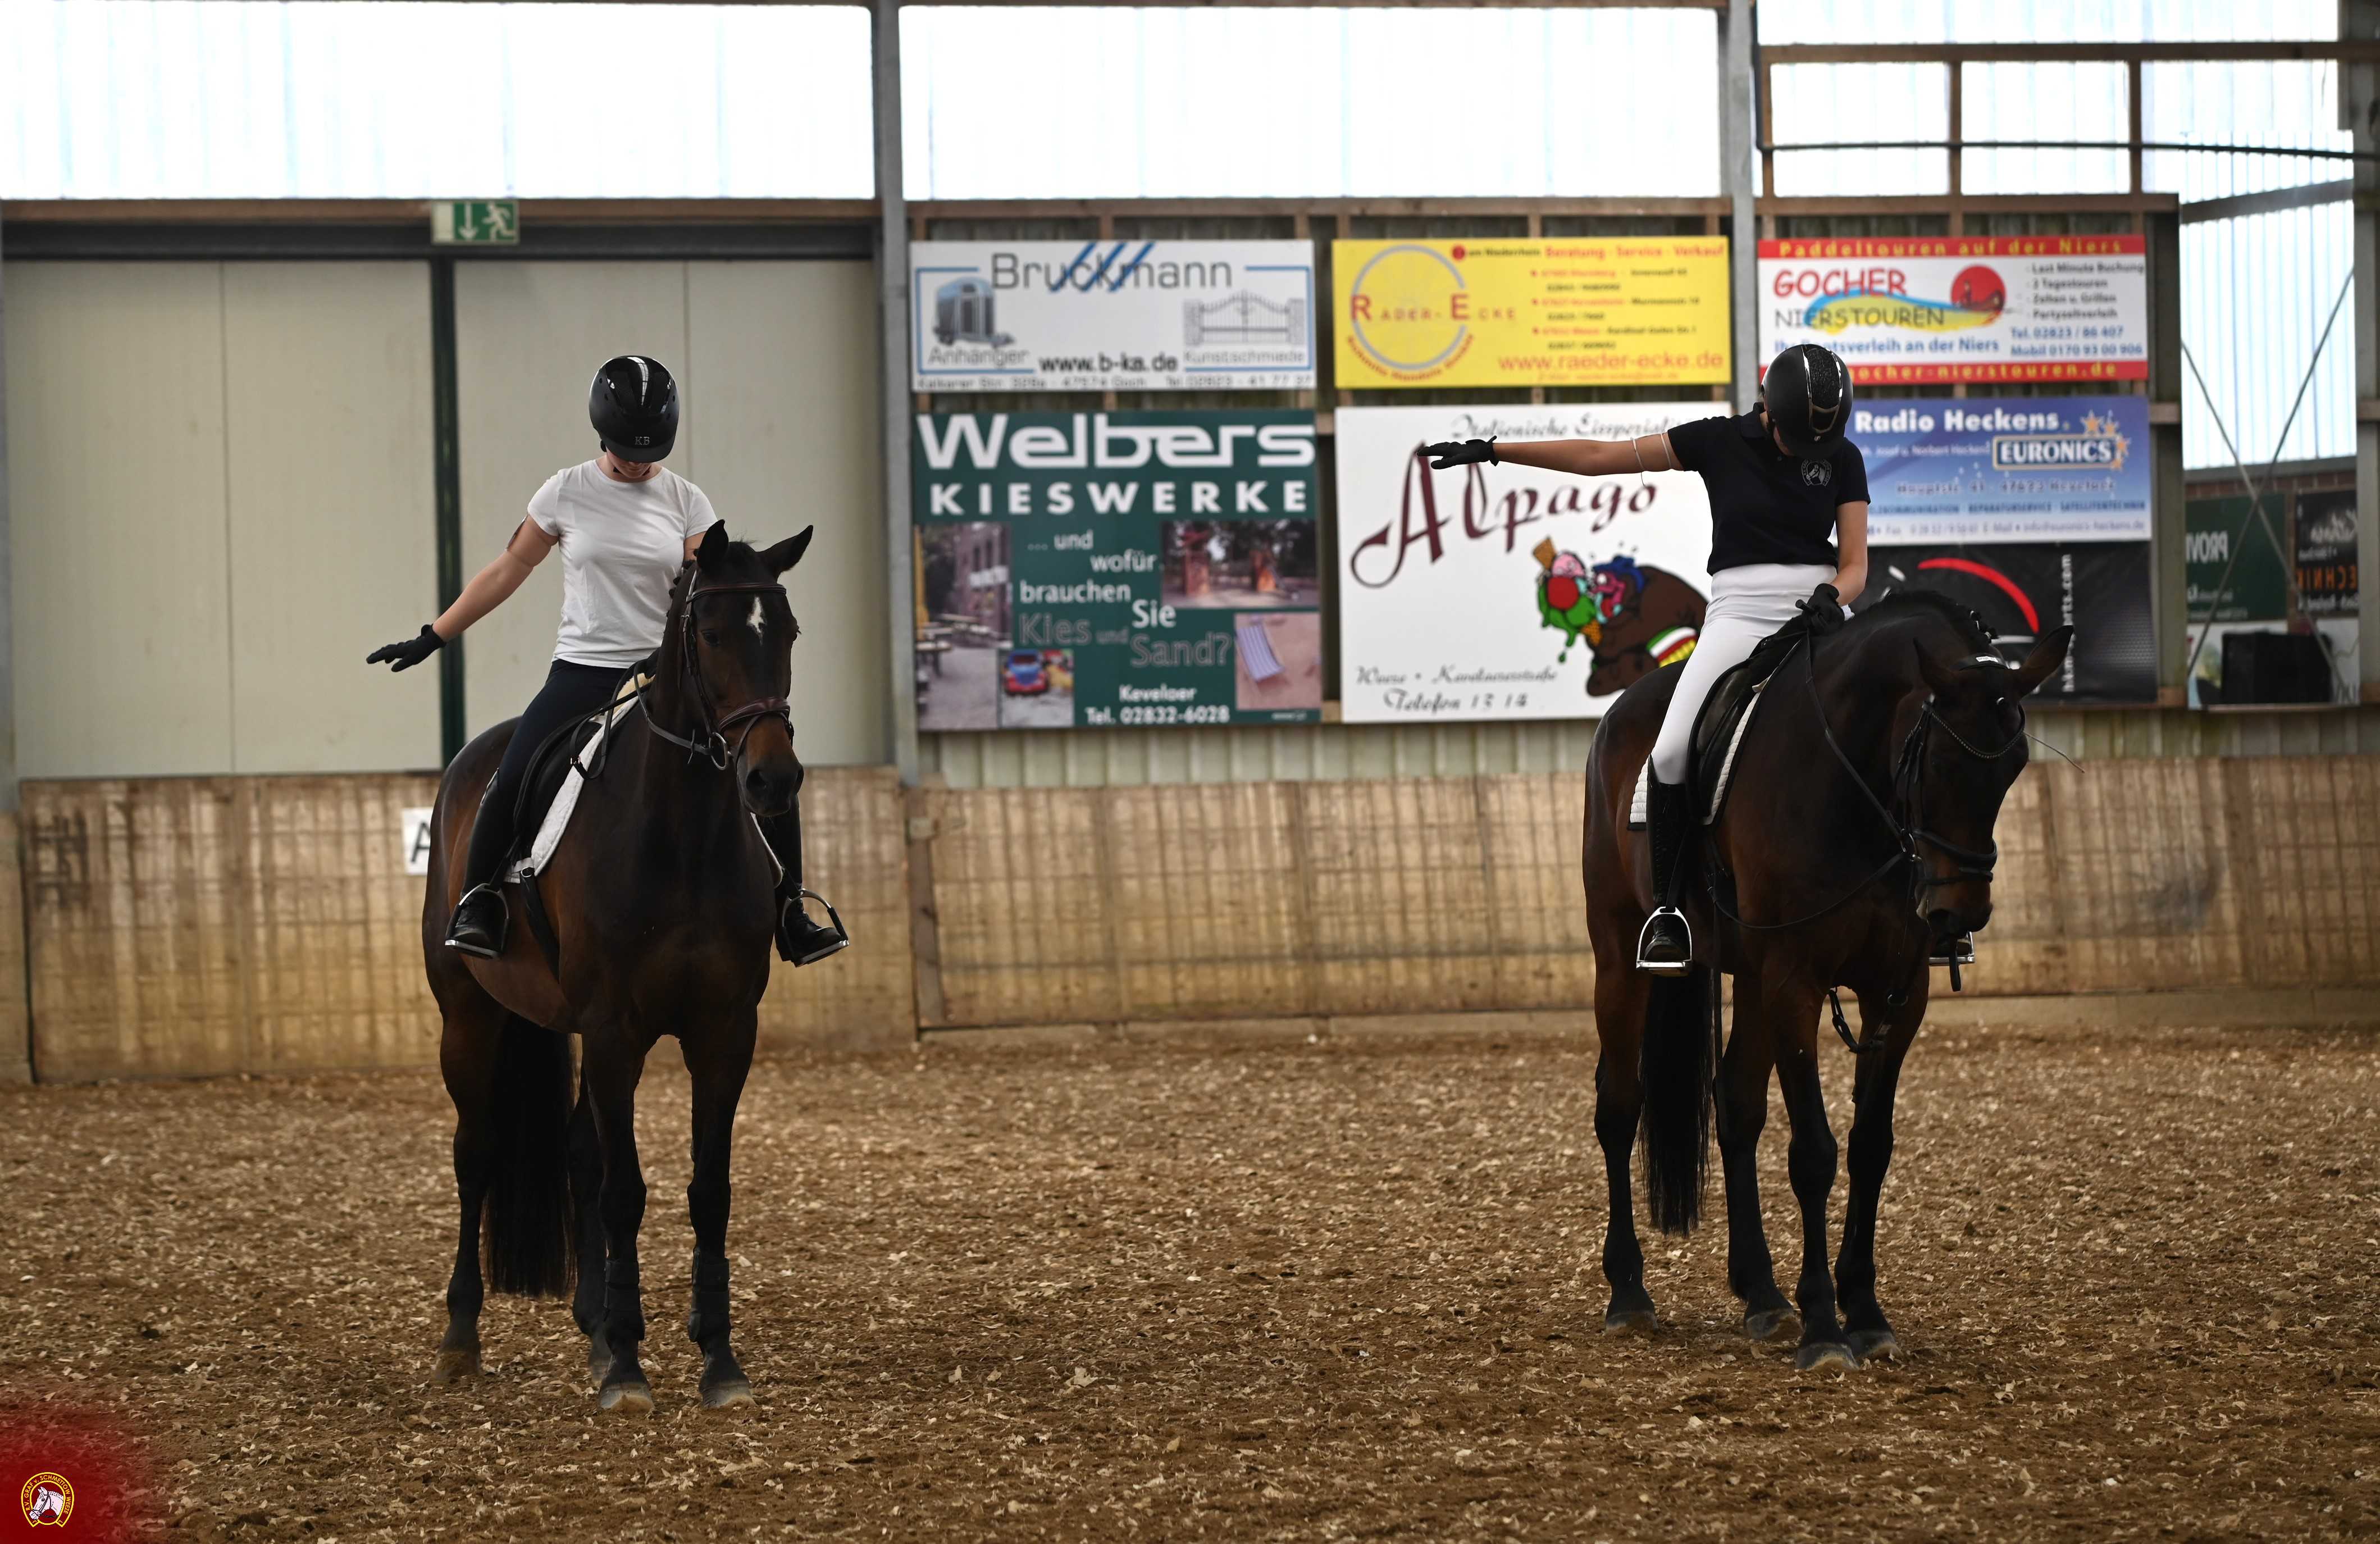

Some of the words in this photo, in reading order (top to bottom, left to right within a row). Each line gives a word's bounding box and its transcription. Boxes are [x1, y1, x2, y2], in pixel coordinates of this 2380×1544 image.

[1545, 247, 1606, 261] Beratung
[1617, 246, 1663, 258] Service
[1674, 245, 1725, 257] Verkauf
[1779, 242, 1946, 257] Paddeltouren
[1959, 240, 1996, 256] auf
[2009, 239, 2046, 255] der
[2059, 239, 2122, 254] Niers
[991, 253, 1233, 289] Bruckmann
[2032, 262, 2054, 272] Last
[2057, 262, 2094, 272] Minute
[2097, 261, 2145, 275] Buchung
[1773, 267, 1907, 298] GOCHER
[2042, 277, 2108, 292] Tagestouren
[2033, 292, 2067, 304] Zelten
[1775, 305, 1944, 328] NIERSTOUREN
[2033, 325, 2072, 338] 02823
[2101, 325, 2124, 337] 407
[1905, 341, 1922, 352] an
[1927, 340, 1954, 352] der
[1959, 339, 1999, 352] Niers
[2011, 344, 2047, 356] Mobil
[2049, 344, 2080, 356] 0170
[2101, 343, 2117, 355] 00
[928, 346, 1029, 368] Anhänger
[1038, 352, 1179, 372] www.b-ka.de
[1498, 352, 1724, 370] www.raeder-ecke.de
[1849, 362, 2118, 381] gocher-nierstouren.de
[1854, 410, 1935, 433] Radio
[1944, 407, 2060, 432] Heckens
[634, 436, 651, 445] KB
[917, 414, 1315, 469] Welbers
[2000, 441, 2112, 464] EURONICS
[931, 480, 1307, 515] KIESWERKE
[1349, 440, 1658, 589] Alpago
[1054, 529, 1094, 550] und
[1089, 548, 1158, 572] wofür
[1019, 580, 1132, 604] brauchen
[1132, 599, 1177, 629] Sie
[1018, 612, 1093, 646] Kies
[1096, 627, 1129, 645] und
[1130, 632, 1233, 667] Sand?
[1383, 687, 1461, 714] Telefon
[1084, 707, 1116, 725] Tel.
[1119, 705, 1230, 725] 02832-6028
[411, 821, 431, 863] A
